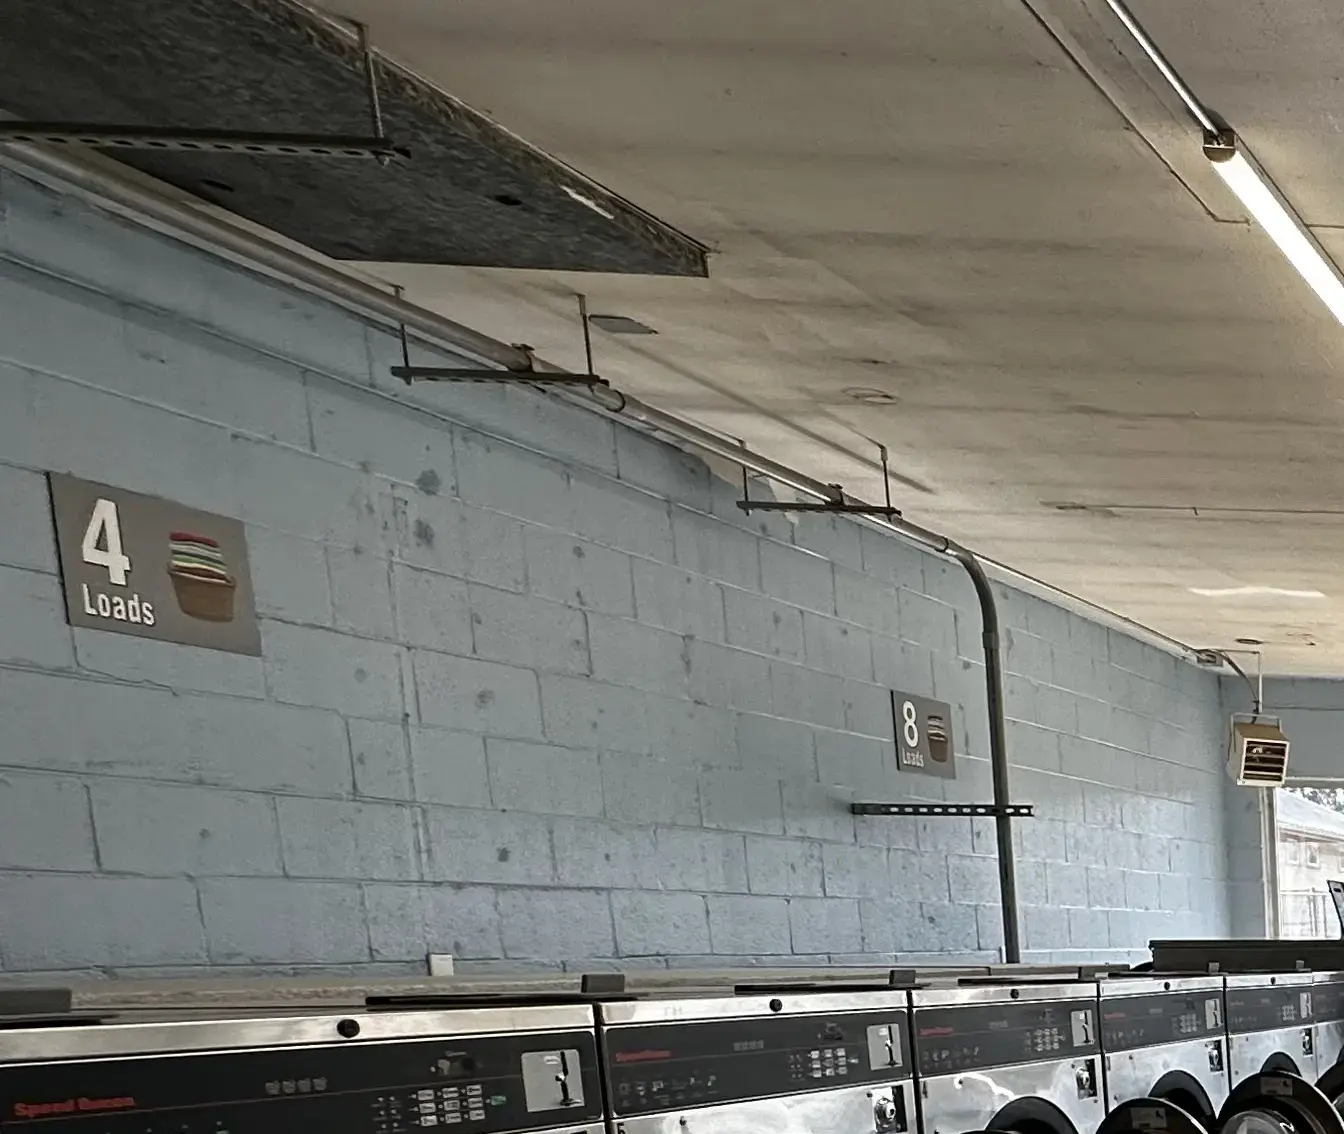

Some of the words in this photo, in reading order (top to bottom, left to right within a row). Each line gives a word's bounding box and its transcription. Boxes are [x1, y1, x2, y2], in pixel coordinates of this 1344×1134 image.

[82, 498, 131, 586] 4
[82, 583, 155, 626] Loads
[903, 700, 919, 748] 8
[902, 747, 924, 768] Loads
